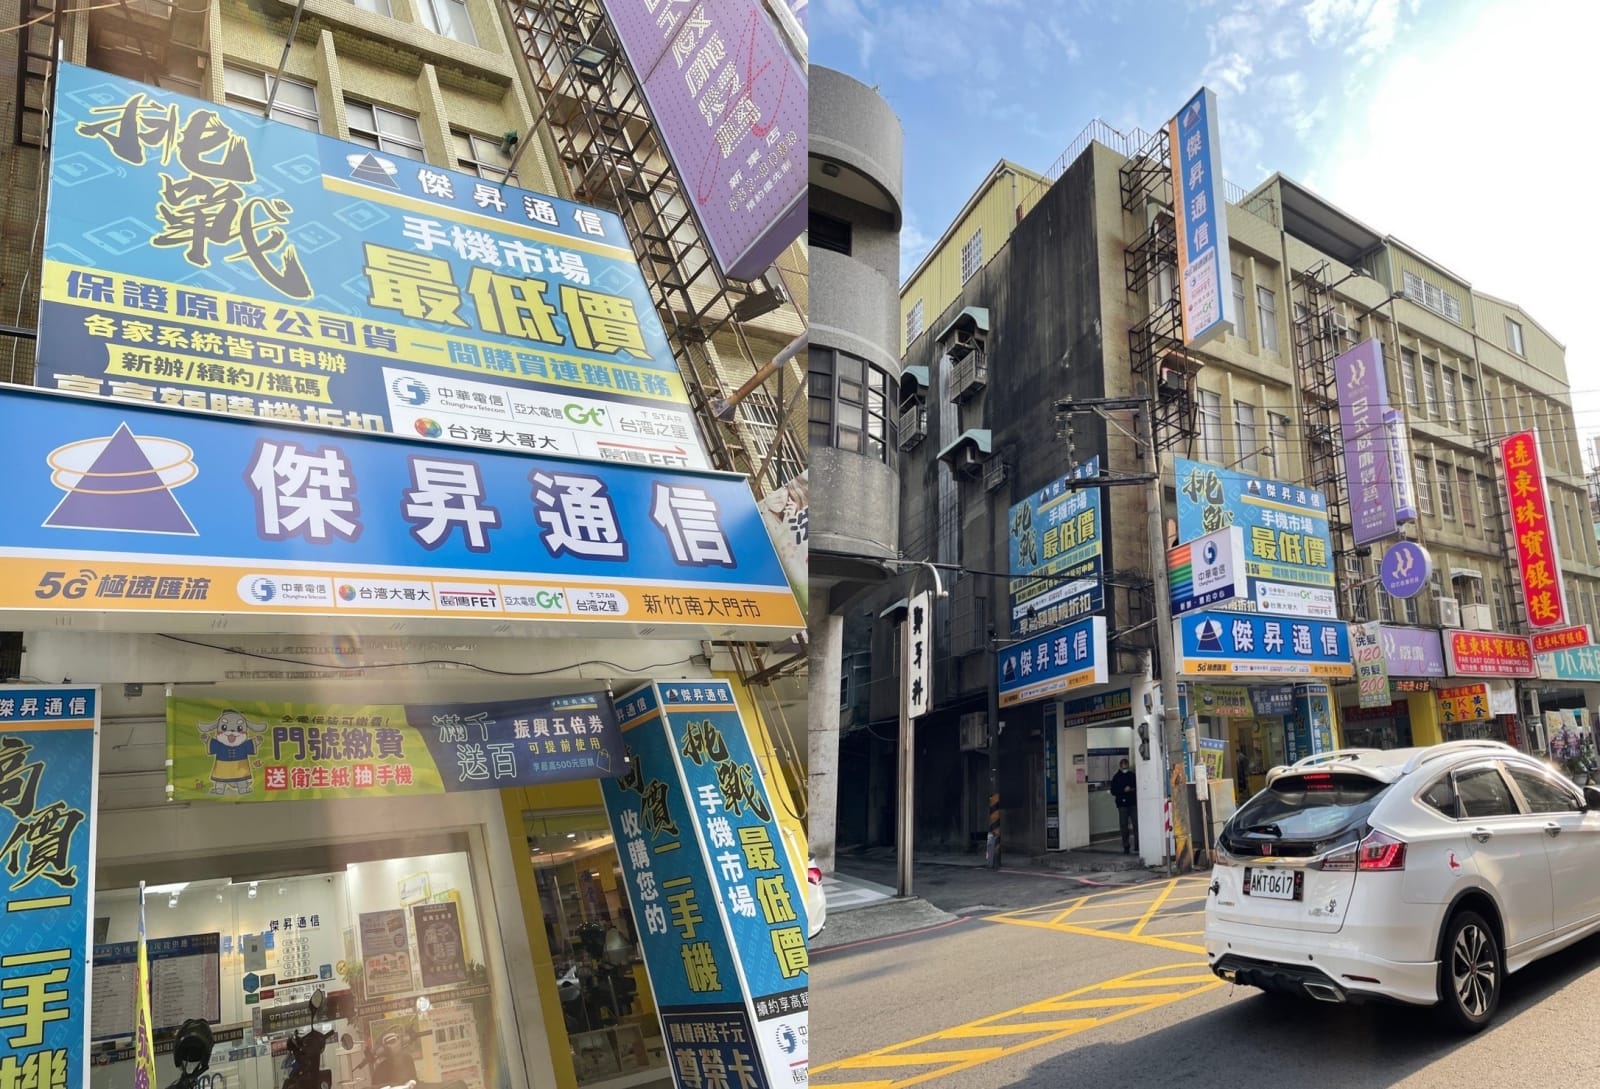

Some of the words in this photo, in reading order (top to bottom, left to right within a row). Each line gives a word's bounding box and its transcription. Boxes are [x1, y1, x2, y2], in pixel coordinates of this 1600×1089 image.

[75, 93, 314, 299] 挑戰
[417, 169, 605, 238] 傑昇通信
[1186, 129, 1209, 252] 傑昇通信
[402, 216, 591, 286] 手機市場
[362, 242, 656, 361] 最低價
[66, 270, 399, 352] 保證原廠公司貨
[411, 340, 673, 397] 一間購買連鎖服務
[84, 314, 348, 375] 各家系統皆可申辦
[121, 351, 322, 397] 新辦/續約/攜碼
[437, 387, 505, 408] 中華電信
[514, 402, 564, 419] 亞太電信
[651, 412, 682, 423] STAR
[249, 441, 733, 567] 傑昇通信
[1049, 490, 1087, 526] 手機市場
[1266, 483, 1321, 507] 傑昇通信
[1010, 499, 1038, 569] 挑戰
[1042, 508, 1096, 560] 最低價
[1260, 509, 1314, 535] 手機市場
[1507, 440, 1559, 620] 遠東珠寶銀樓
[1251, 526, 1328, 568] 最低價
[35, 571, 91, 600] 5G
[95, 574, 212, 601] 極速匯流
[281, 583, 327, 594] 中華電信
[1198, 564, 1226, 581] 中華電信
[472, 597, 497, 608] FET
[643, 594, 762, 619] 新竹南大門市
[1019, 629, 1089, 678] 傑昇通信
[1231, 619, 1339, 656] 傑昇通信
[1357, 646, 1381, 663] 120
[1456, 635, 1529, 659] 遠東珠寶銀樓
[1535, 630, 1585, 650] 遠東珠寶銀樓
[681, 688, 728, 702] 傑昇通信
[1360, 676, 1385, 696] 200
[0, 695, 88, 718] 傑昇通信
[1470, 694, 1487, 718] 黃金
[272, 725, 406, 763] 門號繳費
[432, 711, 497, 744] 滿千
[513, 715, 604, 739] 振興五倍券
[457, 741, 518, 782] 送百
[528, 738, 601, 755] 可提前使用
[263, 762, 414, 791] 送衛生紙抽手機
[681, 719, 772, 824] 挑戰
[0, 736, 85, 891] 高價
[697, 784, 757, 918] 手機市場
[620, 808, 668, 935] 收購您的
[1250, 874, 1293, 894] AKT-0617
[737, 824, 808, 980] 最低價
[269, 914, 320, 932] 傑昇通信
[675, 1047, 757, 1089] 尊榮卡
